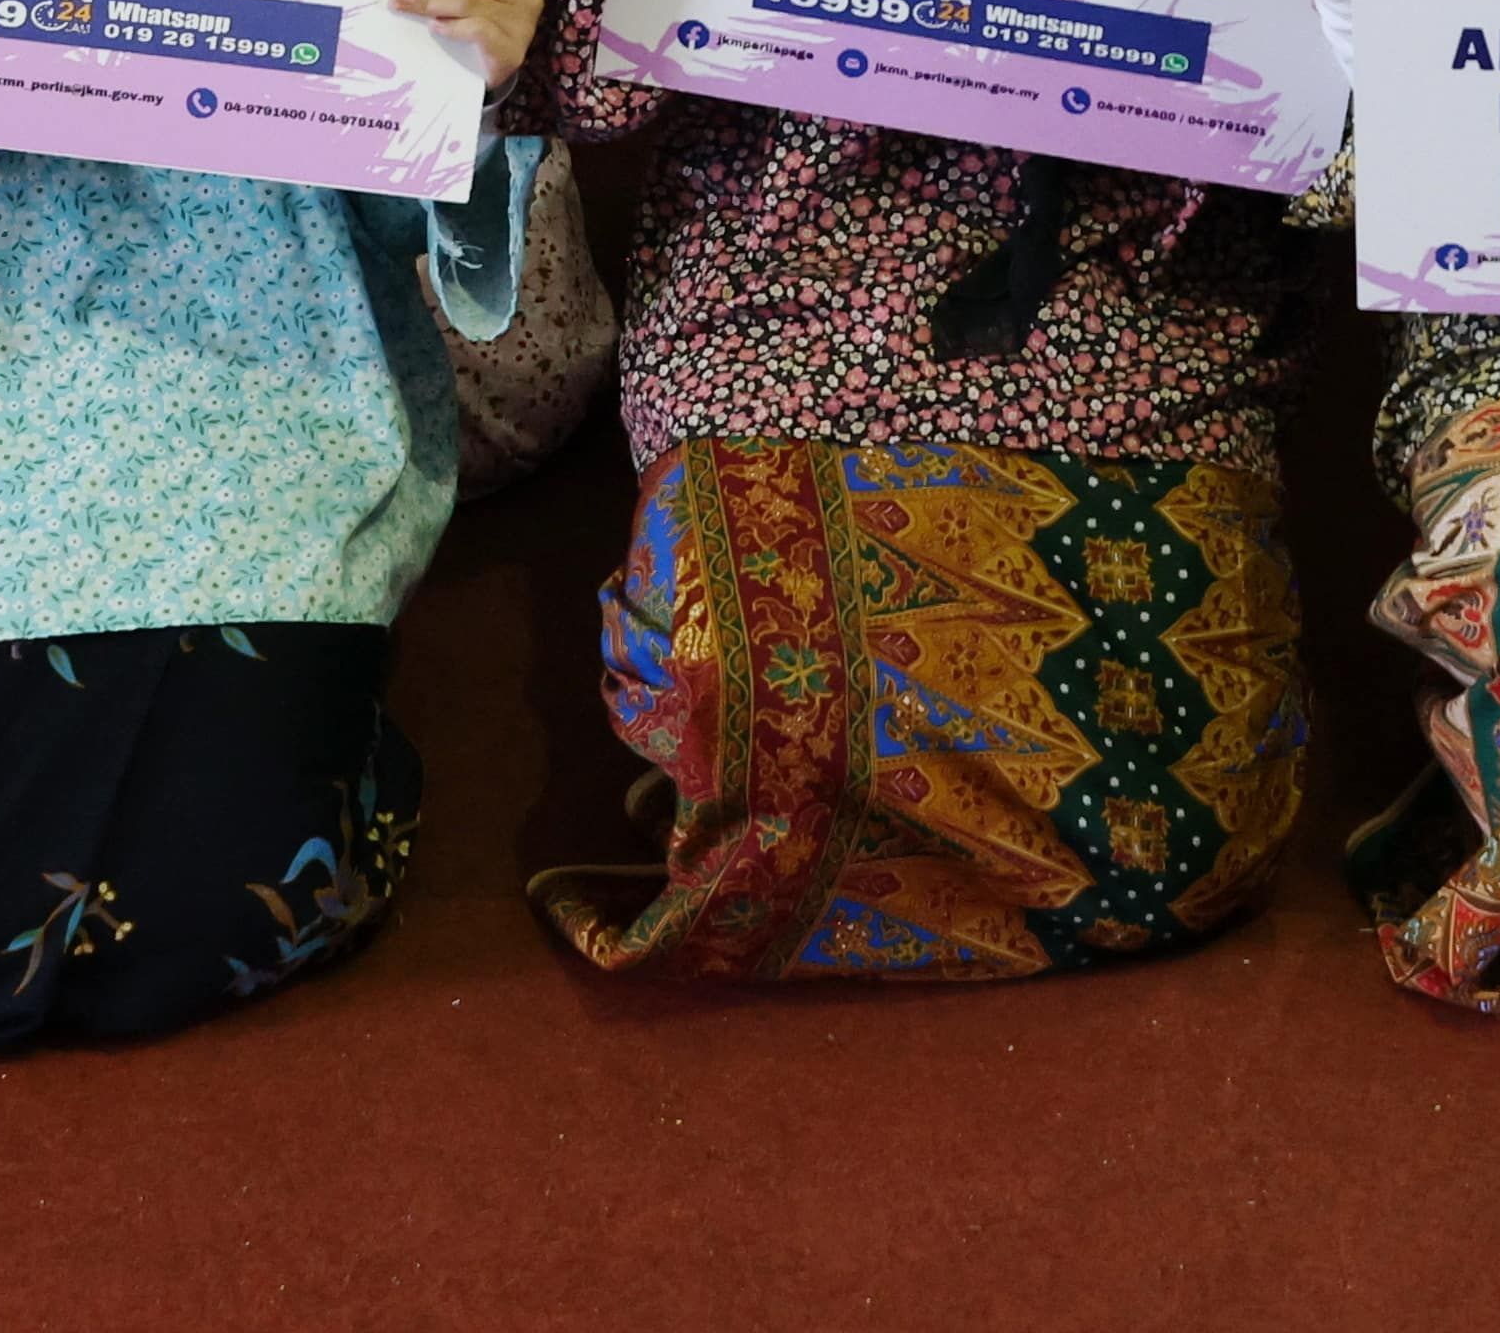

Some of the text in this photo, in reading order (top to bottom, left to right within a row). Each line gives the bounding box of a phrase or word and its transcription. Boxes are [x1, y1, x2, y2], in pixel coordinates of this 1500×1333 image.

[54, 0, 94, 25] 24
[105, 0, 232, 36] Whatsapp
[984, 3, 1105, 42] Whatsapp
[102, 23, 287, 59] 019 26 15999
[981, 24, 1157, 67] 019 26 15999
